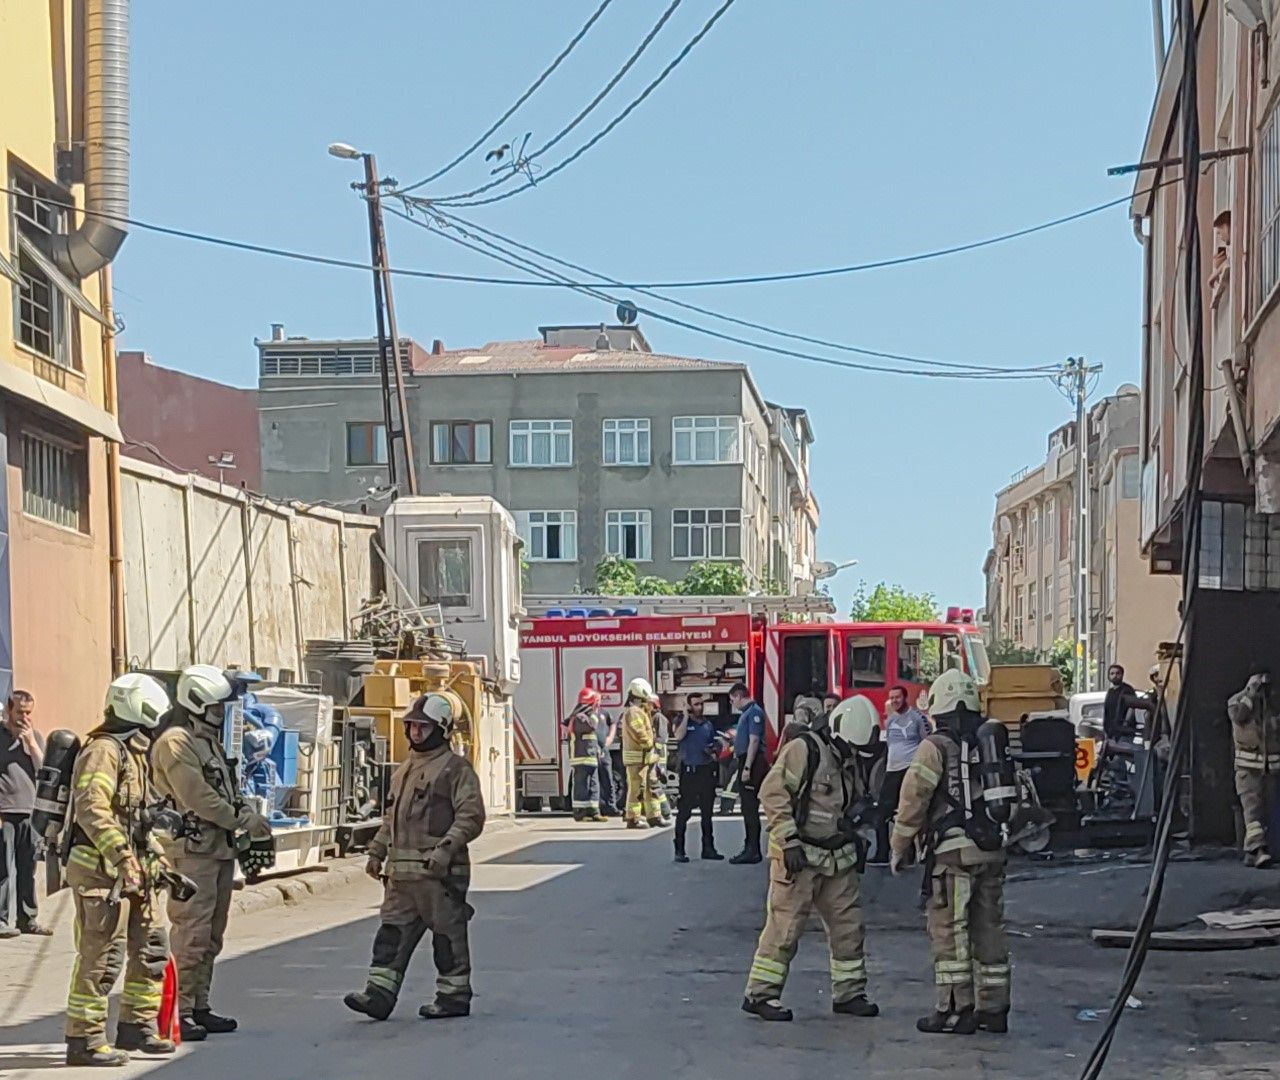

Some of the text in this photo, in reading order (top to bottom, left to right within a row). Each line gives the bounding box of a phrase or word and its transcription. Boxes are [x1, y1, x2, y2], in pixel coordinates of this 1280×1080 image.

[520, 629, 712, 644] TANBUL BÜYÜKŞEHİR BELEDİYESİ
[590, 672, 618, 690] 112
